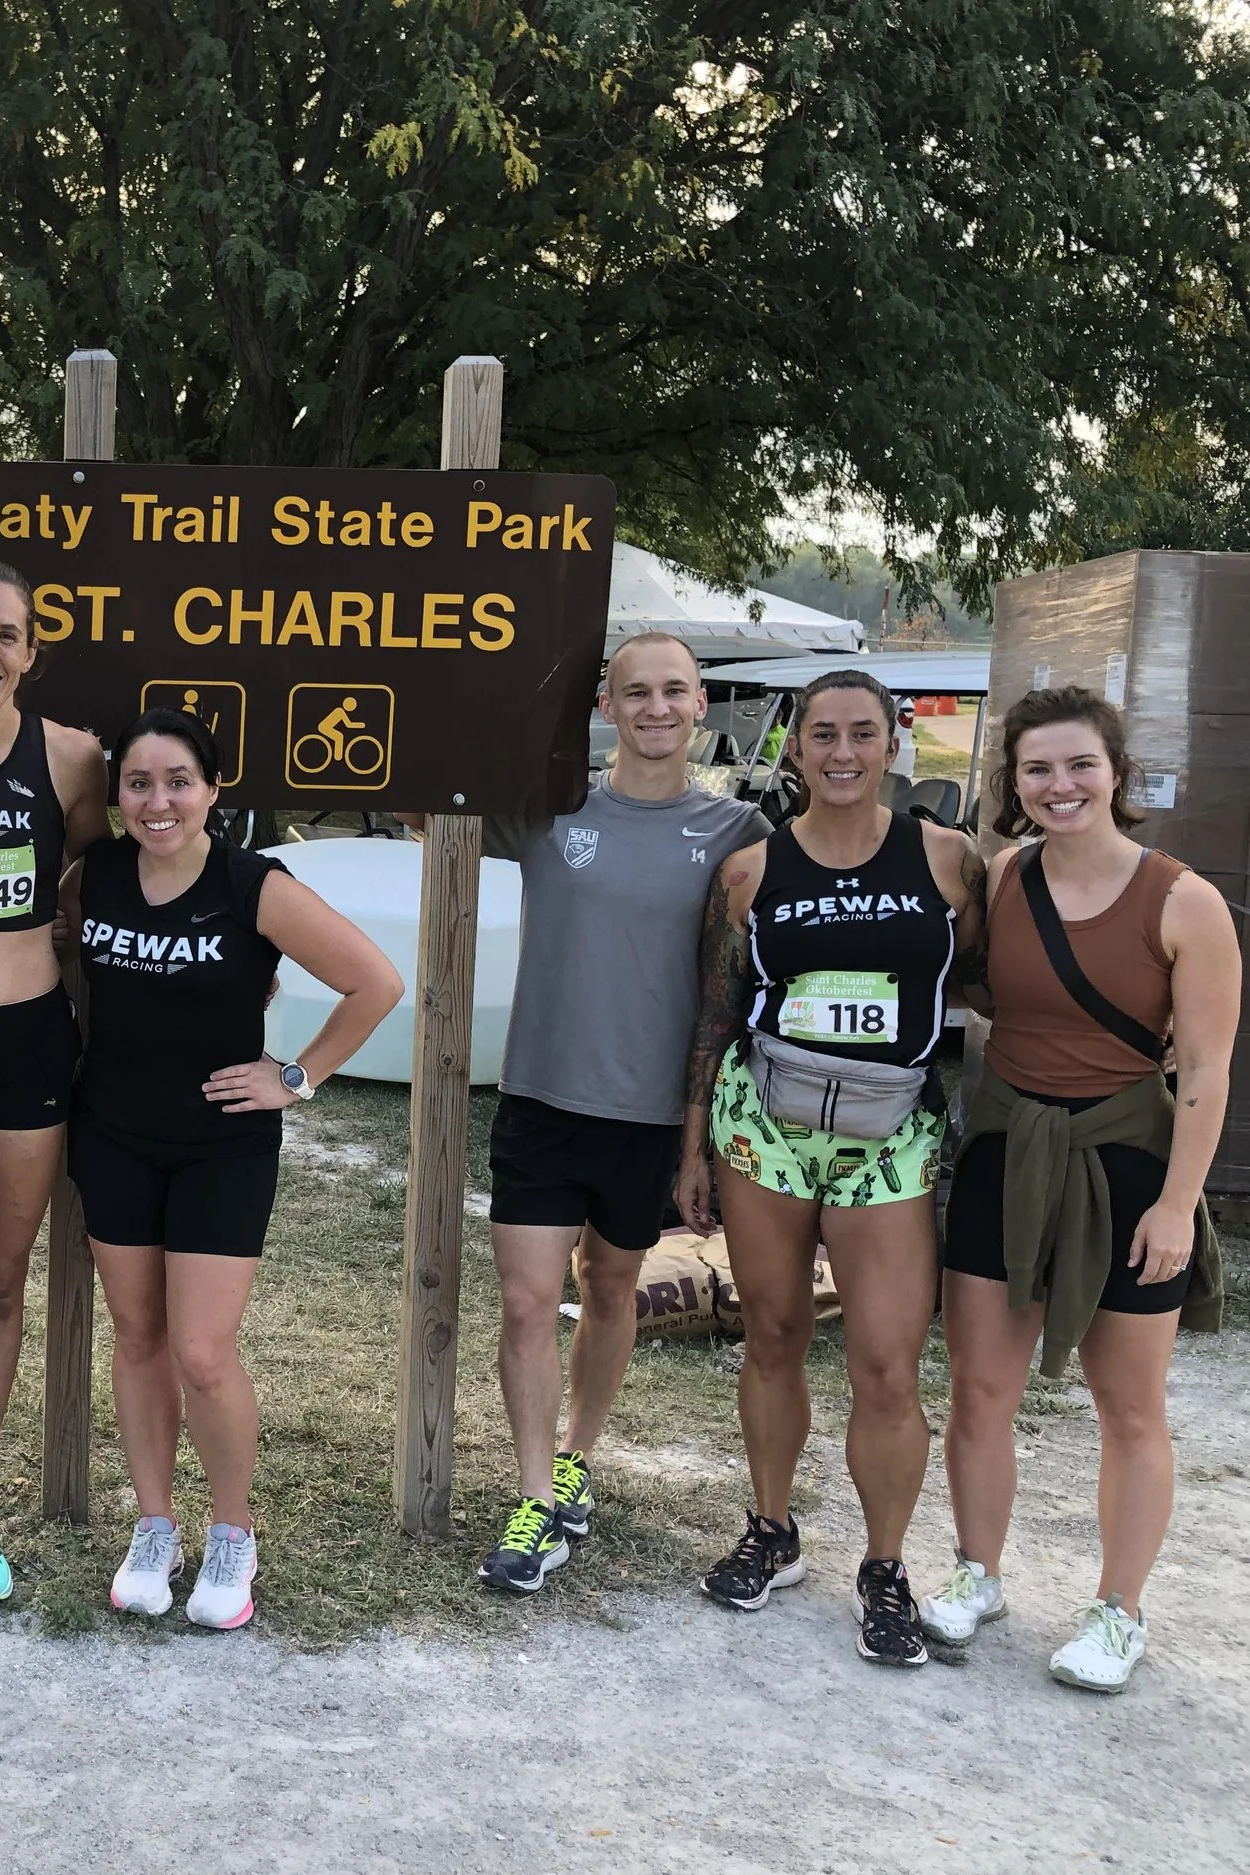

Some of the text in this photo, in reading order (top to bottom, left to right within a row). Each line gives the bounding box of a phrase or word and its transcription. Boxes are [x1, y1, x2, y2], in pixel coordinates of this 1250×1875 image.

[121, 493, 240, 544] Trail
[270, 495, 436, 549] State
[466, 501, 594, 552] Park
[33, 584, 517, 652] ST. CHARLES
[570, 830, 596, 843] SAU
[690, 847, 707, 865] 14
[774, 893, 925, 923] SPEWAK
[823, 912, 874, 924] RACING
[81, 918, 224, 962] SPEWAK
[112, 957, 164, 974] RACING
[805, 974, 877, 987] Saint Charles
[805, 985, 873, 997] Oktoberfest
[828, 1003, 885, 1034] 118
[636, 1317, 683, 1335] eneral
